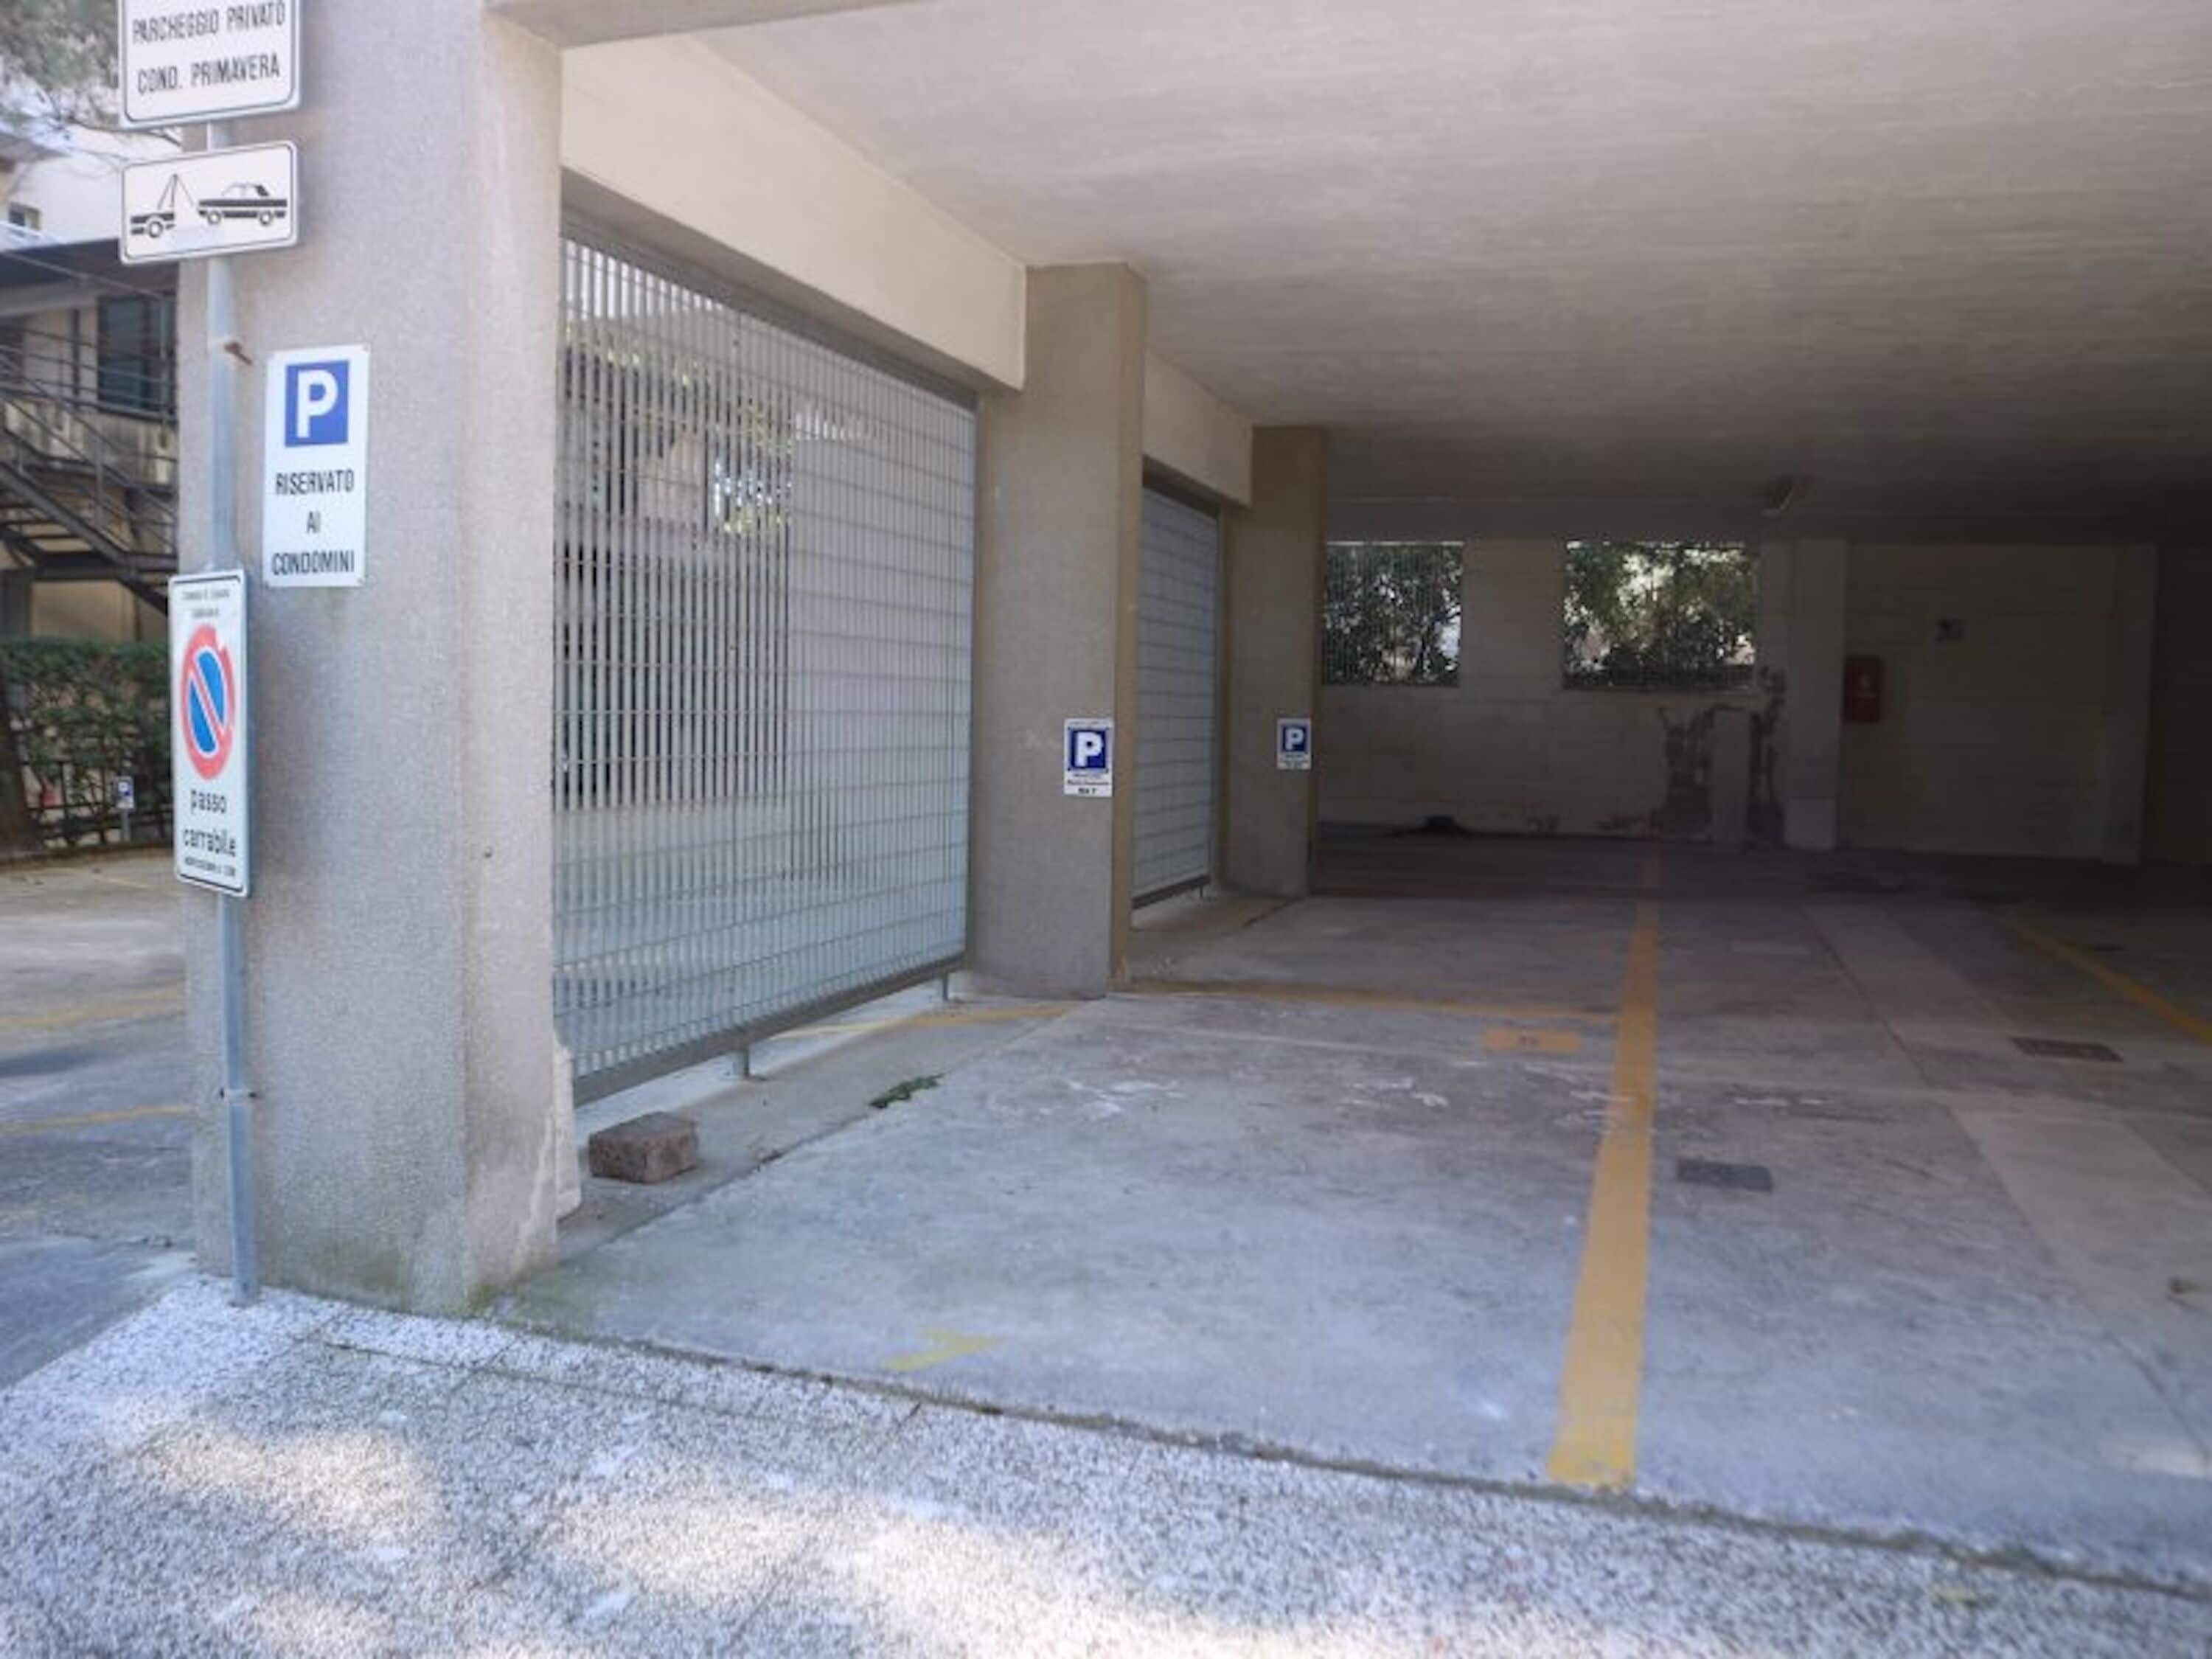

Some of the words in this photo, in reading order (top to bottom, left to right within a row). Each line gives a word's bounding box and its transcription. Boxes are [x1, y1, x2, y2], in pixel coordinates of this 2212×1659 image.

[132, 8, 219, 44] PARCHEGGIO
[137, 66, 183, 95] COND.
[190, 52, 280, 86] PRIMAVERA
[296, 369, 338, 438] P
[276, 468, 354, 495] RISERVATO
[307, 511, 321, 534] AI
[271, 550, 354, 575] CONDOMINI
[1077, 731, 1102, 767] P
[1285, 728, 1304, 751] P
[190, 788, 226, 815] passo
[183, 828, 235, 858] carrabile
